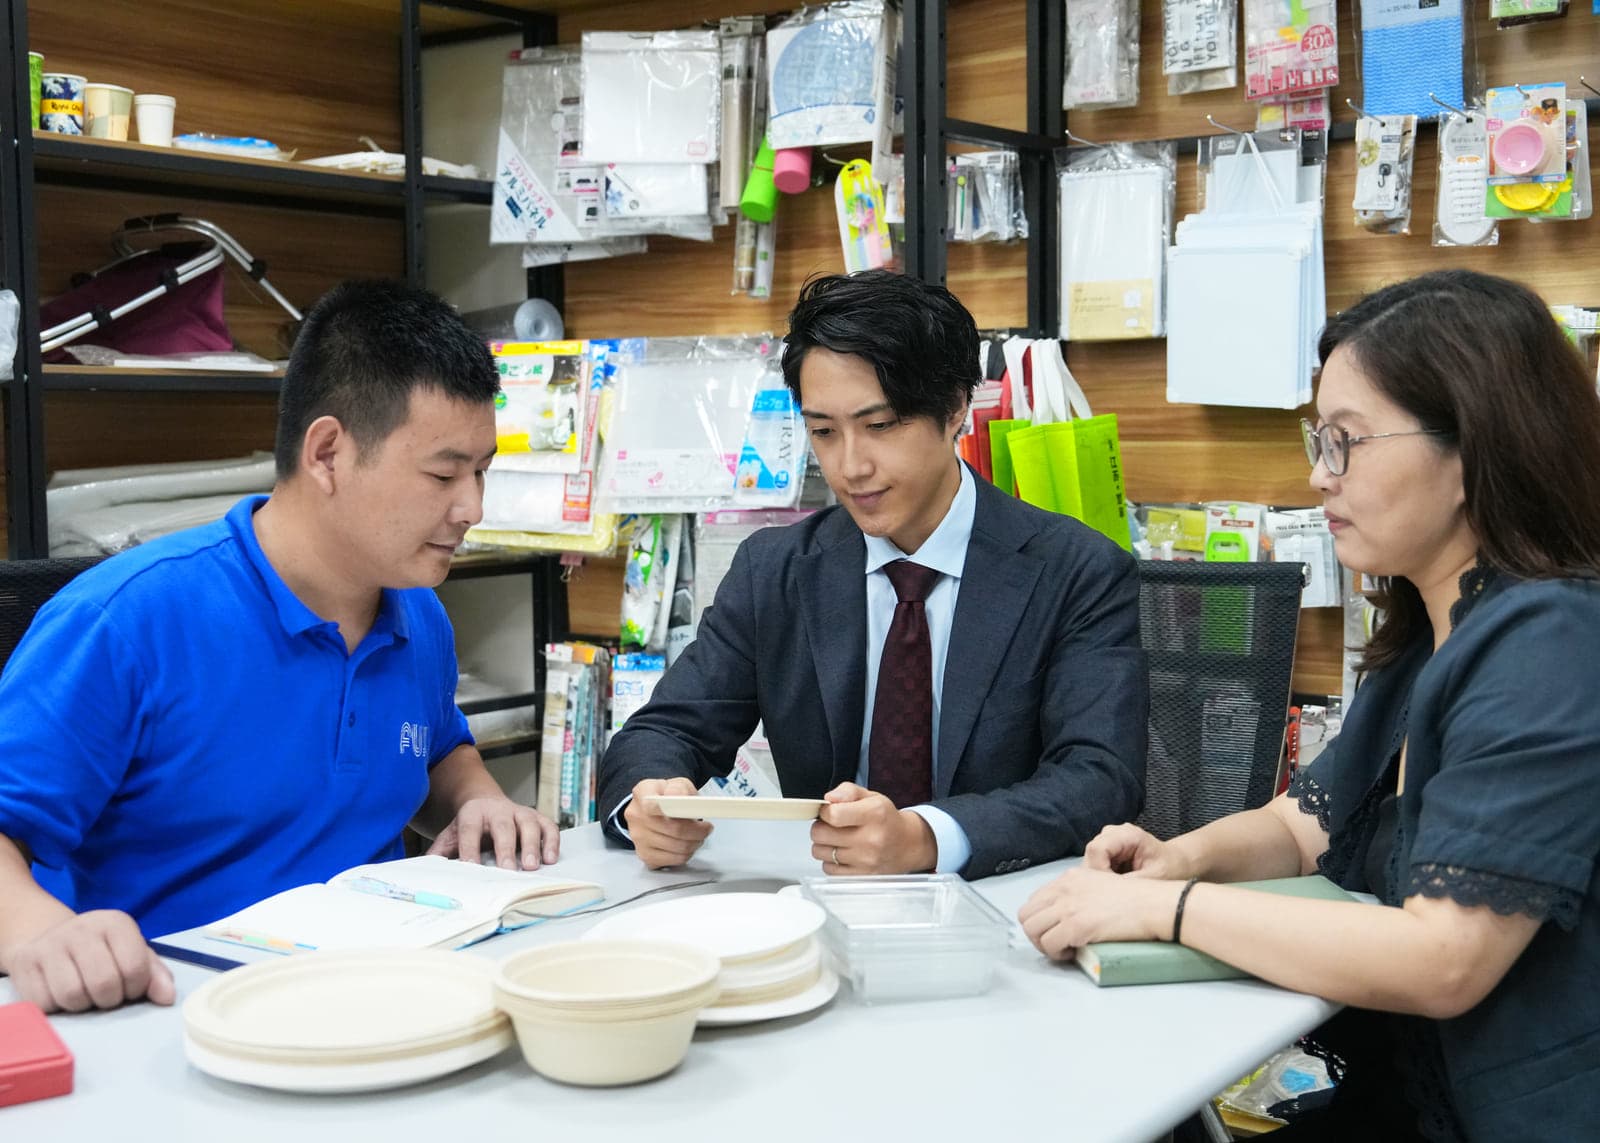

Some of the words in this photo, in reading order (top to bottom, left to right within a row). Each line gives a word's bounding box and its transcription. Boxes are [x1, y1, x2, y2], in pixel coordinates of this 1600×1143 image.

[500, 165, 547, 230] アルミパネル
